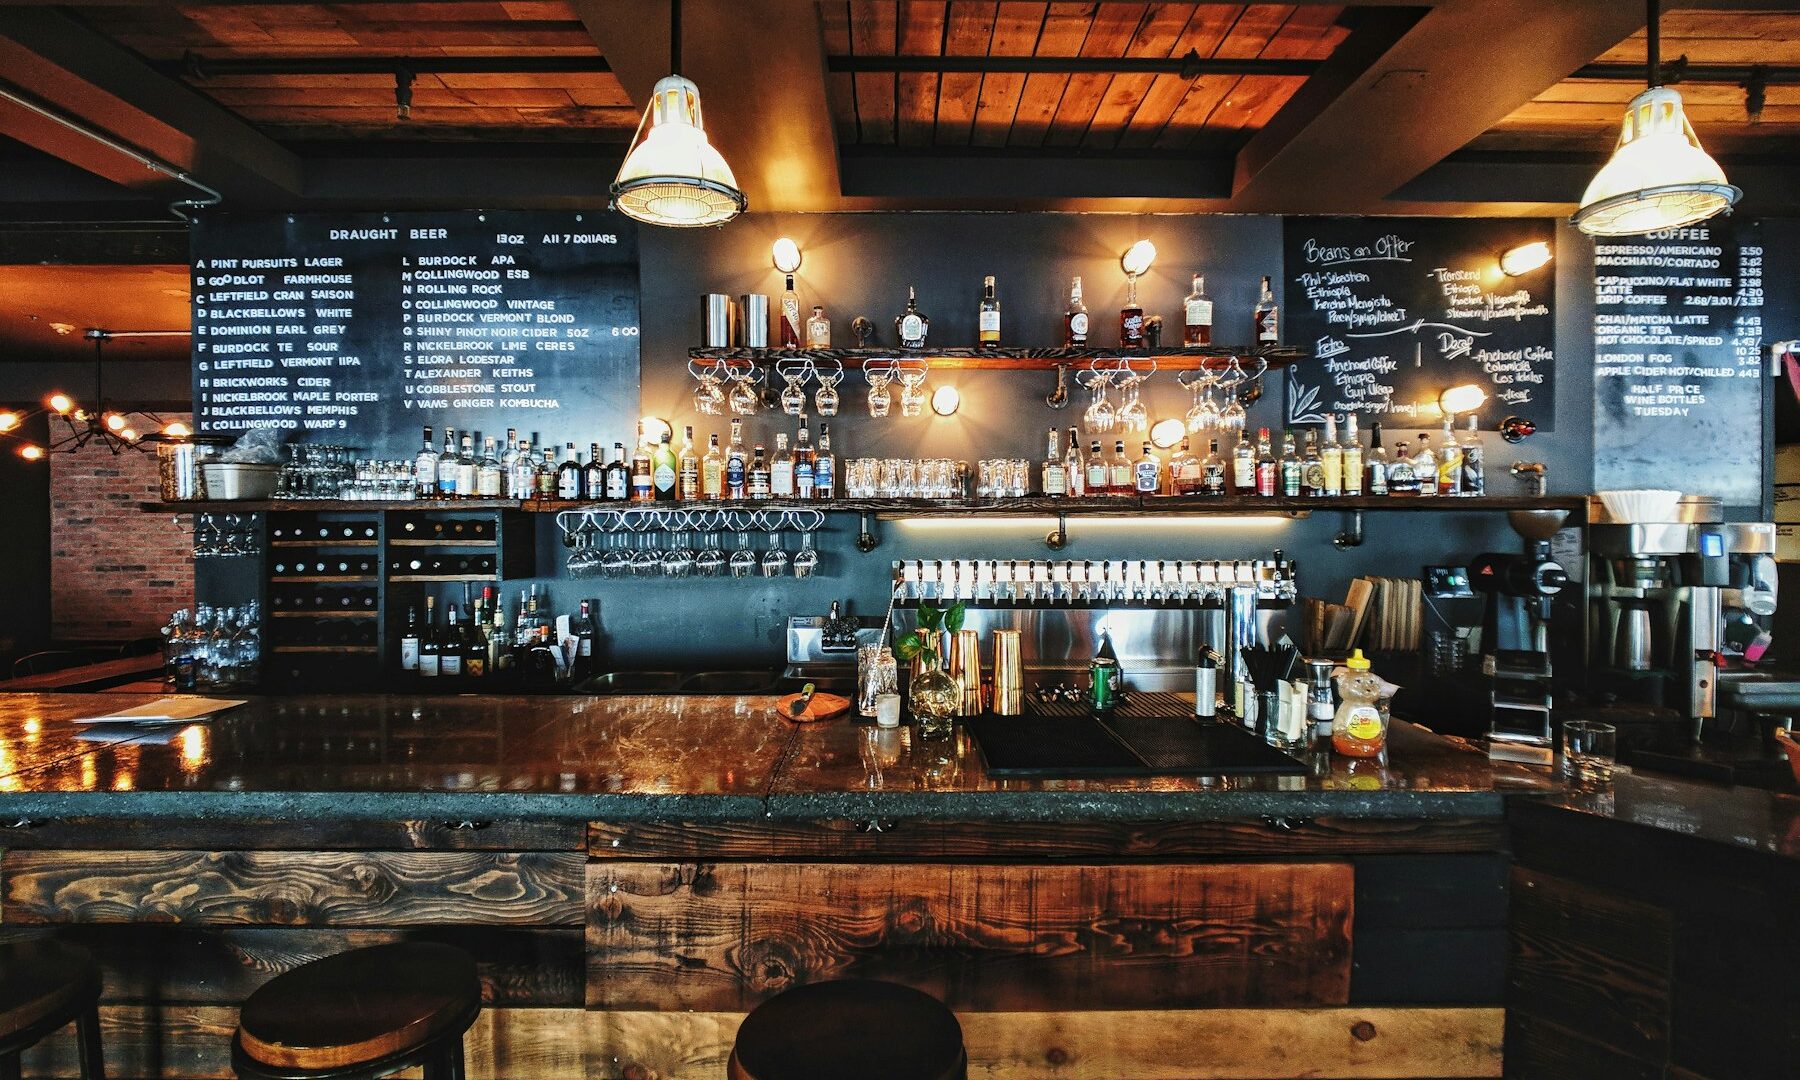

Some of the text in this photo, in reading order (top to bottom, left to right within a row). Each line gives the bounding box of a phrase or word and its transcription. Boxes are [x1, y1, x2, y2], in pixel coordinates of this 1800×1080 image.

[330, 229, 447, 239] DRAUGHT BEER
[564, 235, 570, 243] 7
[1646, 229, 1710, 240] COFFEE
[1304, 239, 1350, 263] Beans
[1376, 235, 1415, 258] Offer
[1596, 246, 1763, 255] ESPRESSO/AMERICANO 3.50
[197, 258, 343, 268] A PINT PURSUITS LAGER
[403, 256, 515, 265] L BURDOCK APA
[1596, 257, 1719, 268] MACCHIATO/CORTADO
[402, 270, 529, 281] M COLLINGWOOD ESB
[1739, 268, 1762, 276] 3.95
[197, 274, 352, 285] B GOODLOT FARMHOUSE
[1697, 278, 1732, 287] WHITE
[403, 285, 502, 294] N ROLLING ROCK
[1307, 286, 1351, 299] Ethiopia
[1443, 283, 1480, 296] Ethiopia
[1596, 286, 1633, 294] LATTE
[196, 290, 353, 303] C LEFTFIELD CRAN SAISON
[1596, 295, 1623, 304] DRIP
[1624, 295, 1667, 304] COFFEE
[402, 300, 555, 310] O COLLINGWOOD VINTAGE
[198, 309, 352, 318] D BLACKBELLOWS WHITE
[403, 314, 574, 323] P BURDOCK VERMONT BLOND
[1595, 315, 1673, 325] CHAI/MATCHA
[1675, 316, 1709, 324] LATTE
[198, 325, 345, 335] E DOMINION EARL GREY
[403, 327, 412, 336] Q
[417, 328, 451, 336] SHINY
[457, 328, 488, 336] PINOT
[491, 329, 518, 337] NOIR
[522, 329, 557, 337] CIDER
[1595, 326, 1647, 335] ORGANIC
[1651, 326, 1672, 334] TEA
[1595, 336, 1618, 345] HOT
[1621, 335, 1723, 345] CHOCOLATE/SPIKED
[198, 343, 338, 353] F BURDOCK TE SOUR
[404, 342, 575, 351] R NICKELBROOK LIME CERES
[1523, 346, 1553, 362] Coffee
[1596, 354, 1644, 363] LONDON
[1648, 355, 1672, 363] FOG
[199, 362, 208, 370] G
[214, 359, 273, 370] LEFTFIELD
[281, 357, 333, 367] VERMONT
[405, 356, 514, 364] S ELORA LODESTAR
[405, 369, 533, 379] T ALEXANDER KEITHS
[1595, 367, 1631, 376] APPLE
[1634, 366, 1667, 376] CIDER
[1669, 367, 1735, 377] HOT/CHILLED
[200, 378, 331, 387] H BRICKWORKS CIDER
[1335, 372, 1375, 386] Ethiopia
[405, 384, 536, 394] U COBBLESTONE STOUT
[1631, 385, 1700, 394] HALF PRICE
[213, 393, 287, 402] NICKELBROOK
[293, 393, 330, 401] MAPLE
[336, 393, 378, 401] PORTER
[1624, 395, 1705, 404] WINE BOTTLES
[417, 400, 448, 408] VAMS
[453, 400, 494, 408] GINGER
[500, 400, 559, 408] KOMBUCHA
[201, 406, 357, 416] J BLACKBELLOWS MEMPHIS
[1634, 407, 1689, 416] TUESDAY
[201, 420, 346, 430] K COLLINGWOOD WARP 9
